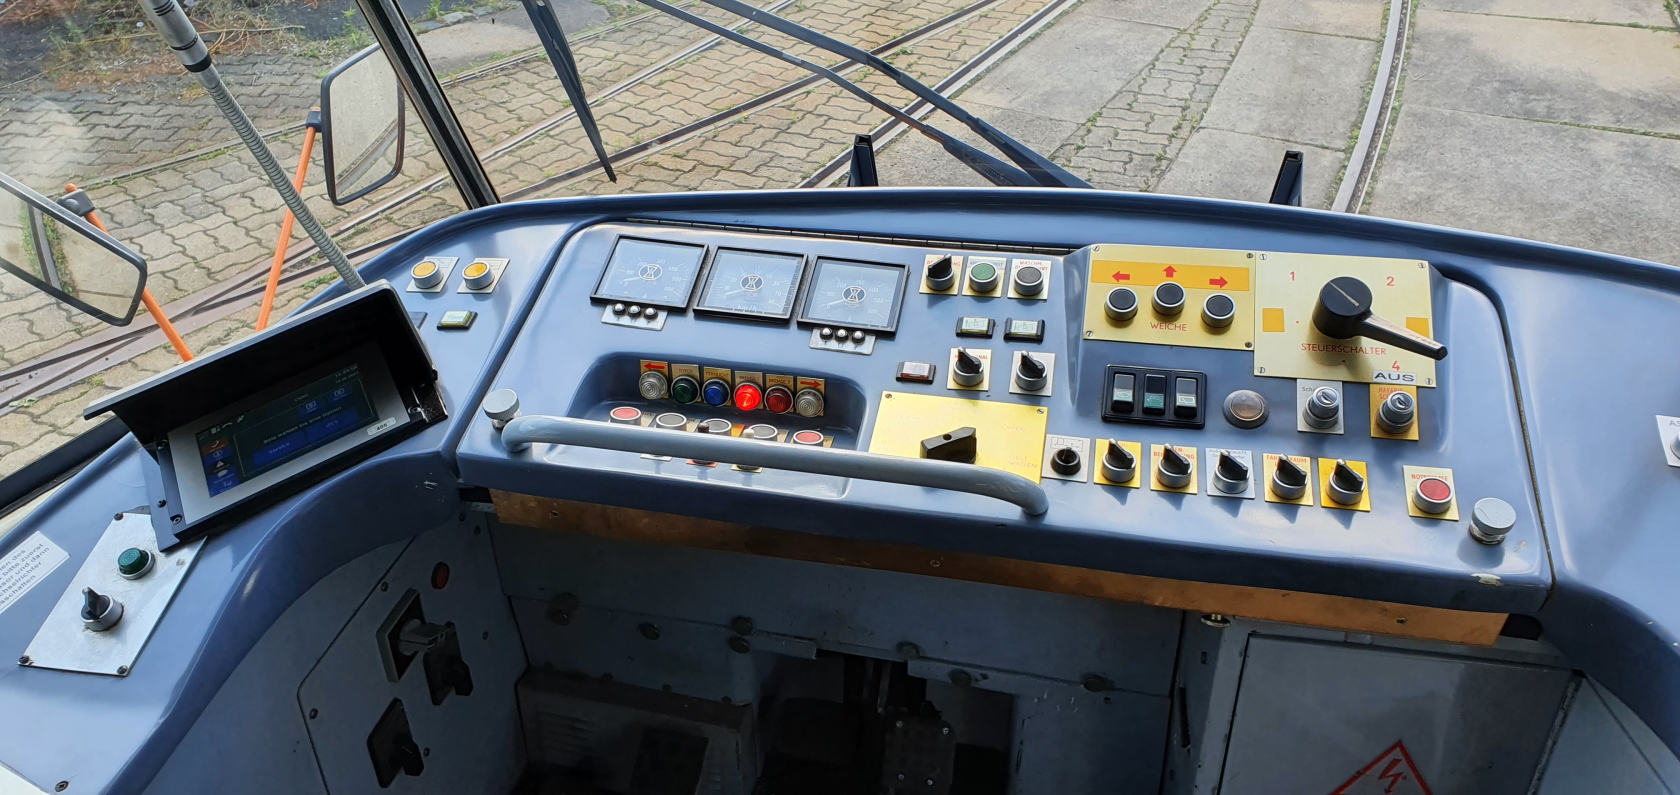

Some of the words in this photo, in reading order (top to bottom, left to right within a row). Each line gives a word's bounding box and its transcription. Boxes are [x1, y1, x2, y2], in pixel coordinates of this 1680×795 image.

[1289, 271, 1296, 281] 1
[1386, 276, 1395, 287] 2
[1150, 321, 1187, 331] WEICHE
[1301, 342, 1387, 356] STEUERSCHALTER
[1391, 360, 1400, 371] 4
[1374, 372, 1415, 382] AUS
[1009, 461, 1037, 469] WAGEN
[2, 561, 20, 577] bitte
[21, 543, 44, 563] zuerst
[12, 549, 26, 561] des
[15, 563, 30, 576] und
[30, 547, 50, 563] dann
